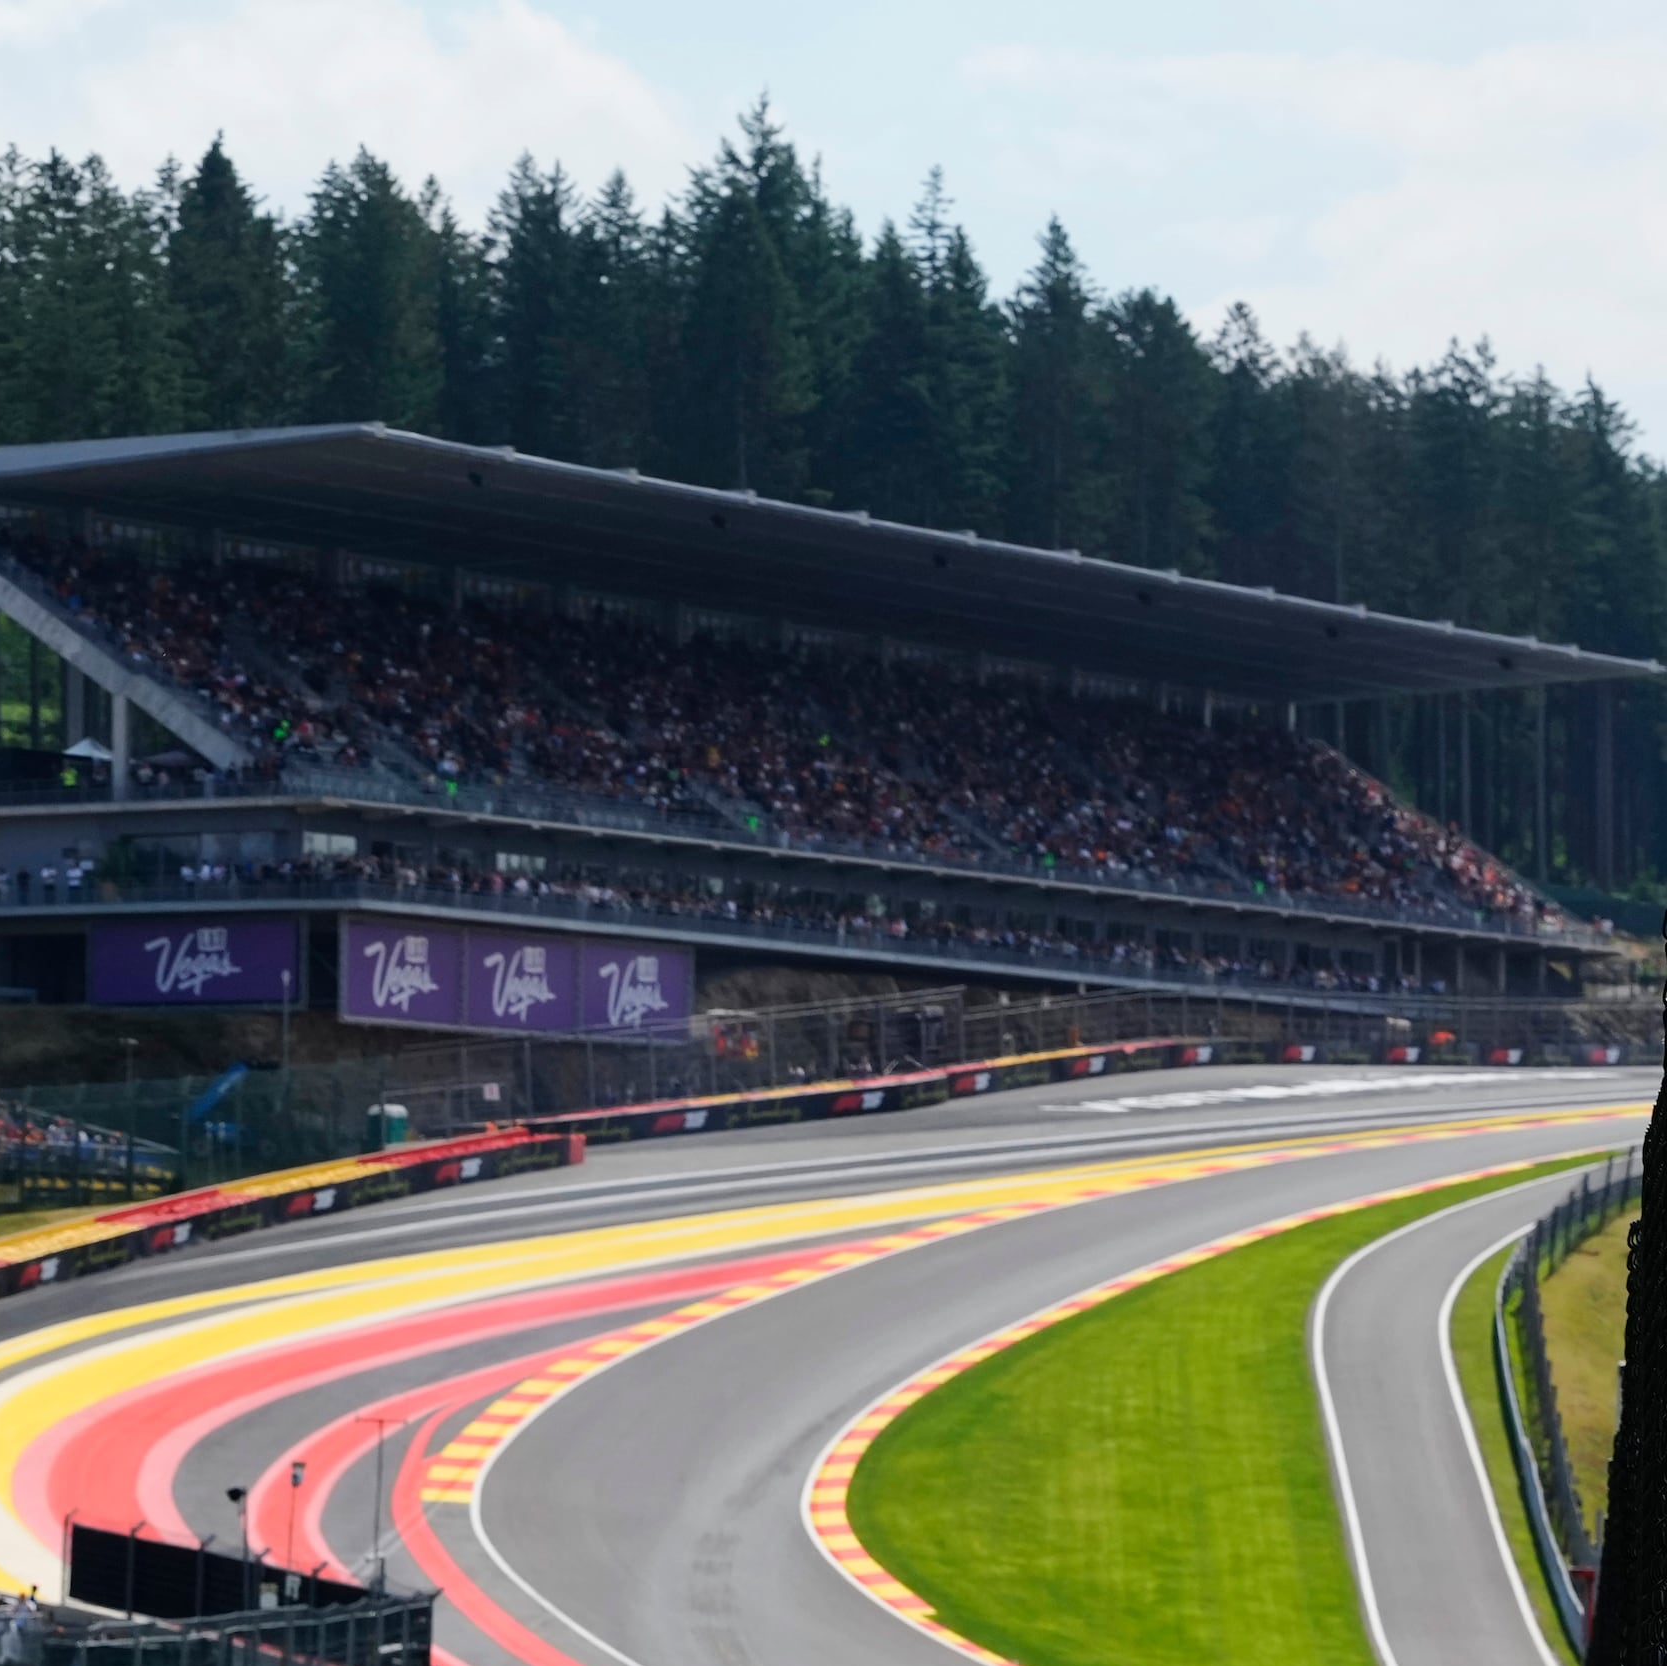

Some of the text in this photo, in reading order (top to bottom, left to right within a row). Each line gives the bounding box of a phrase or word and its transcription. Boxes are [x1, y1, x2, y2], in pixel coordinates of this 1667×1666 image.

[144, 932, 243, 996] Vegas
[363, 938, 439, 1013] Vegas
[483, 949, 557, 1023] Vegas
[598, 958, 669, 1030] Vegas
